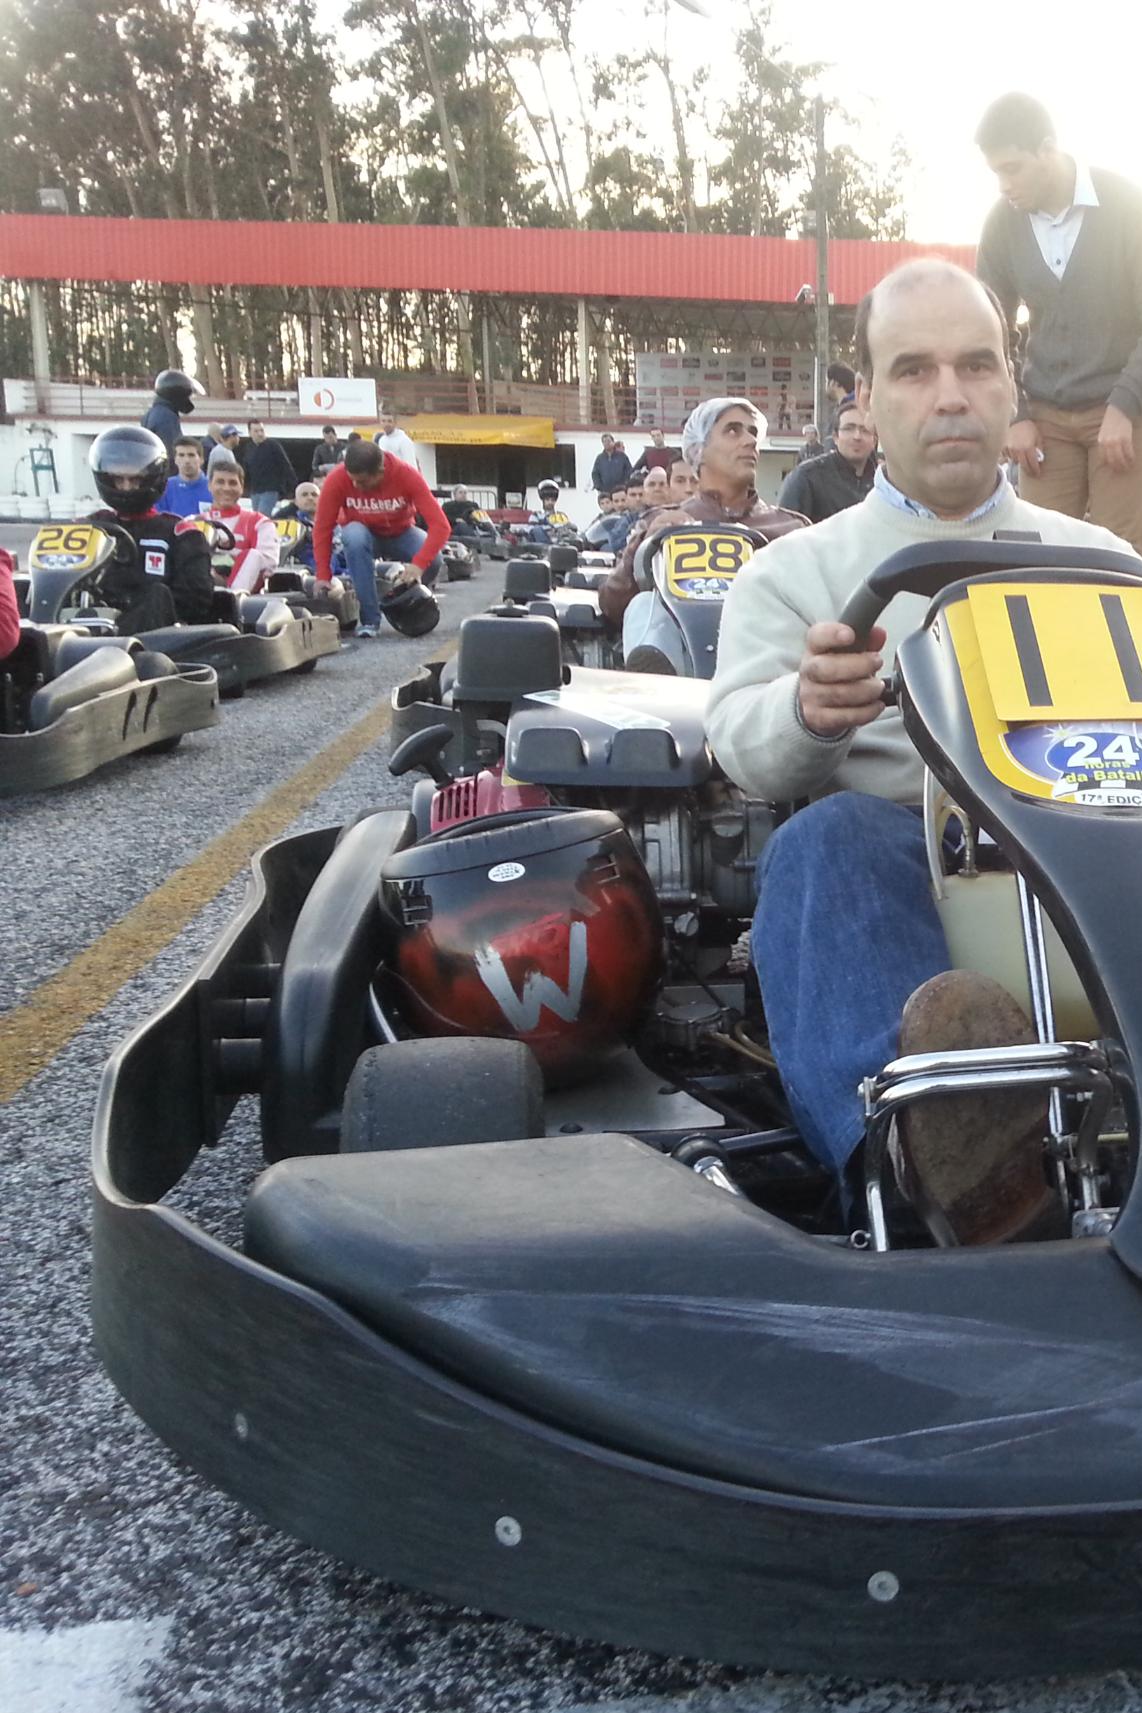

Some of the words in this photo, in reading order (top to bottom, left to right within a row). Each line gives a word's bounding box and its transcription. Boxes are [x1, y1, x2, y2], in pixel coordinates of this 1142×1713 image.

[36, 528, 92, 551] 26
[674, 537, 743, 574] 28
[1063, 735, 1141, 768] 24
[1065, 772, 1090, 784] da
[474, 921, 587, 1032] W
